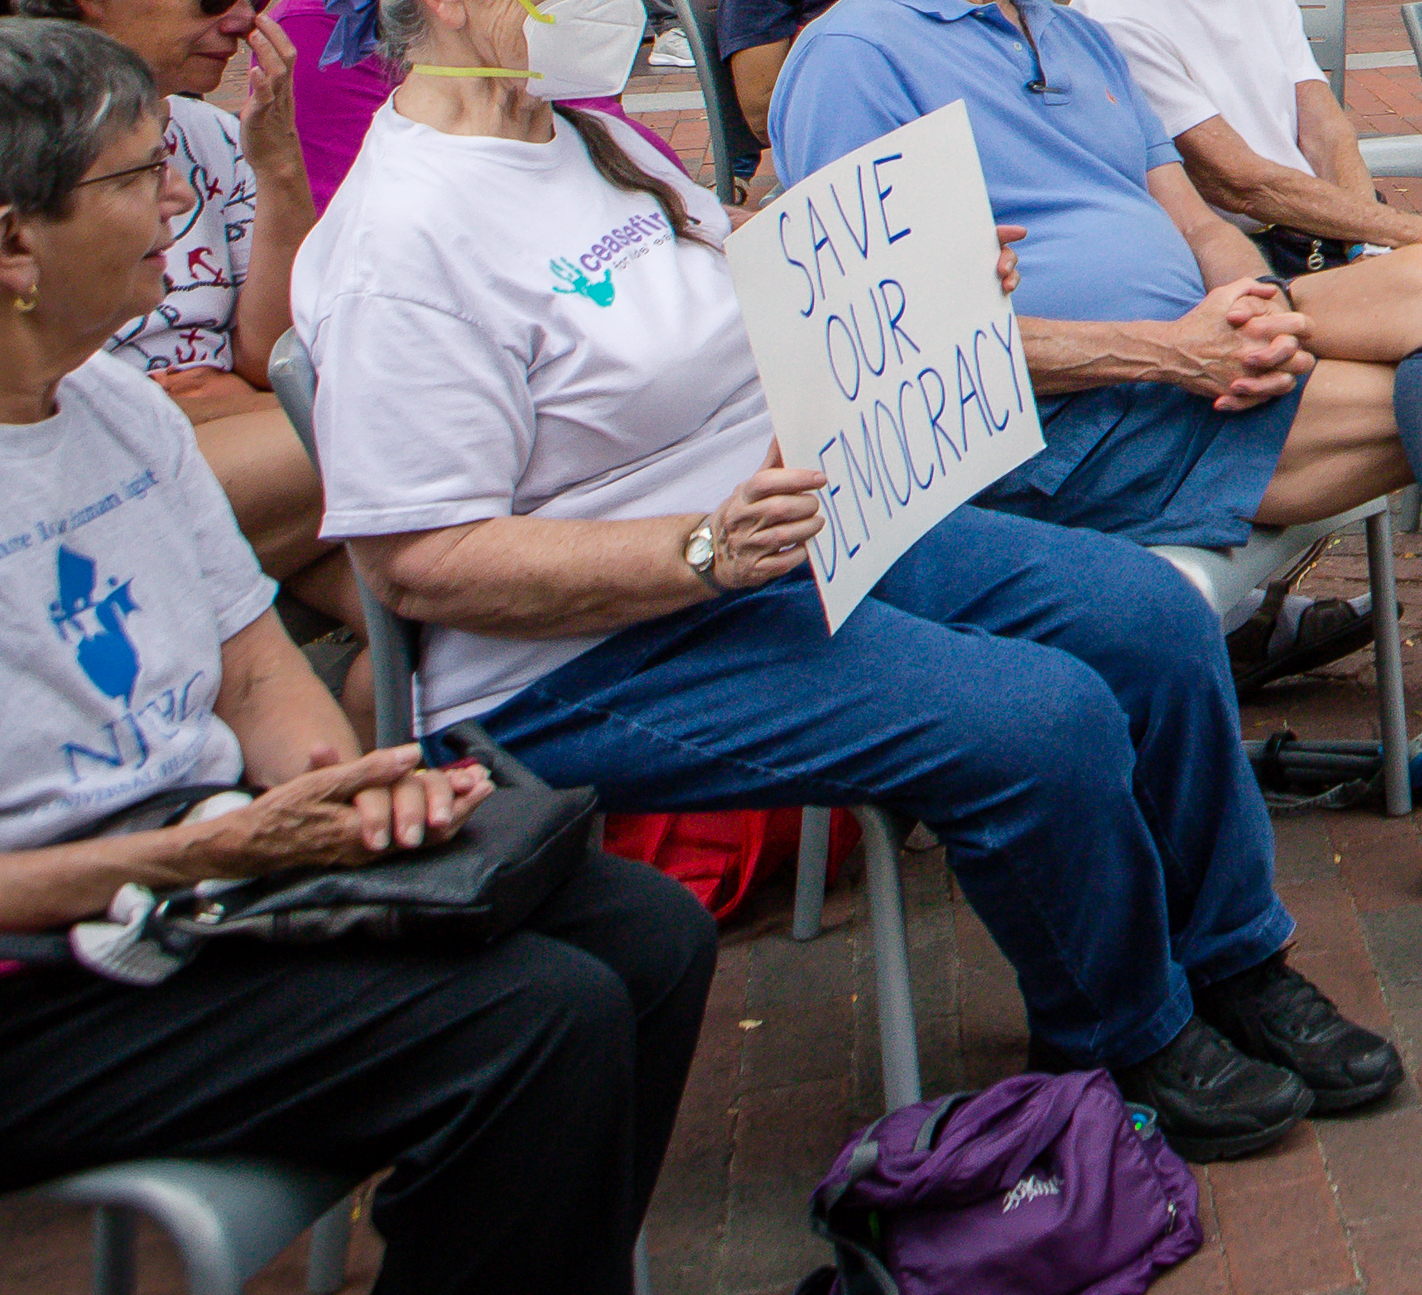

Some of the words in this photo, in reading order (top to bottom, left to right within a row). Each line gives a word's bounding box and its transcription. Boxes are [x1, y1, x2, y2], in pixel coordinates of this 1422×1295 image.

[579, 211, 669, 273] ceasefir
[779, 152, 912, 318] SAVE
[826, 278, 921, 402] OUR
[812, 312, 1024, 584] DEMOCRACY
